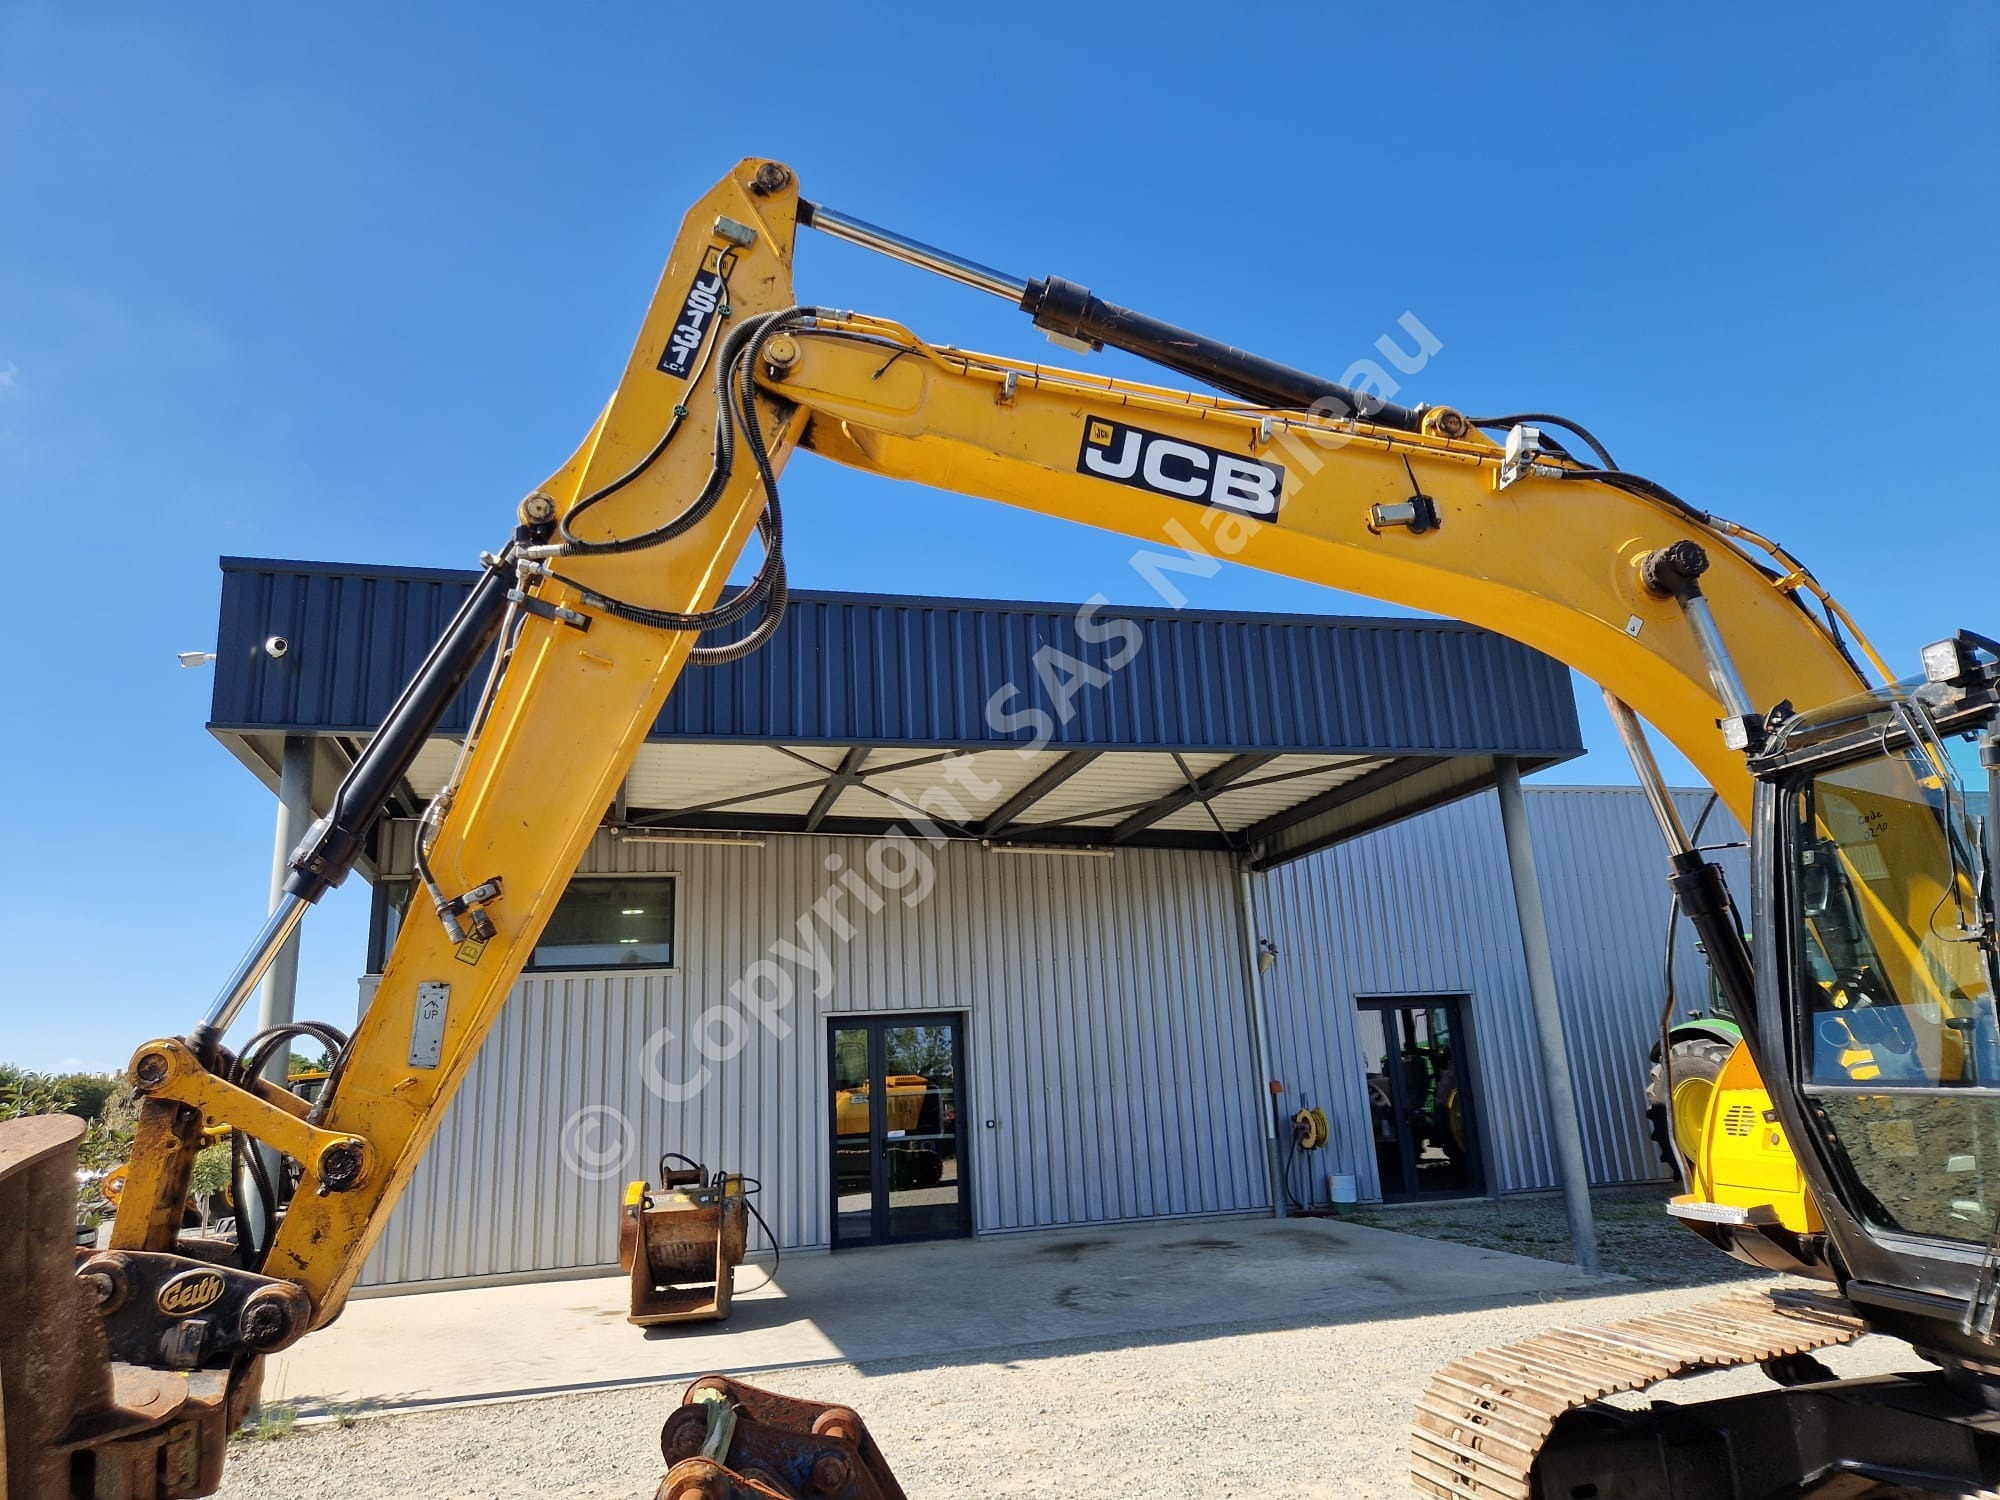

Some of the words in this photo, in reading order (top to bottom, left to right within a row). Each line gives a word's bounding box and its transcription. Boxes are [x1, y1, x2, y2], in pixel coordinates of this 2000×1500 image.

[671, 276, 721, 366] JS131
[663, 360, 686, 373] LC+
[1085, 430, 1277, 515] JCB
[424, 1009, 439, 1020] UP
